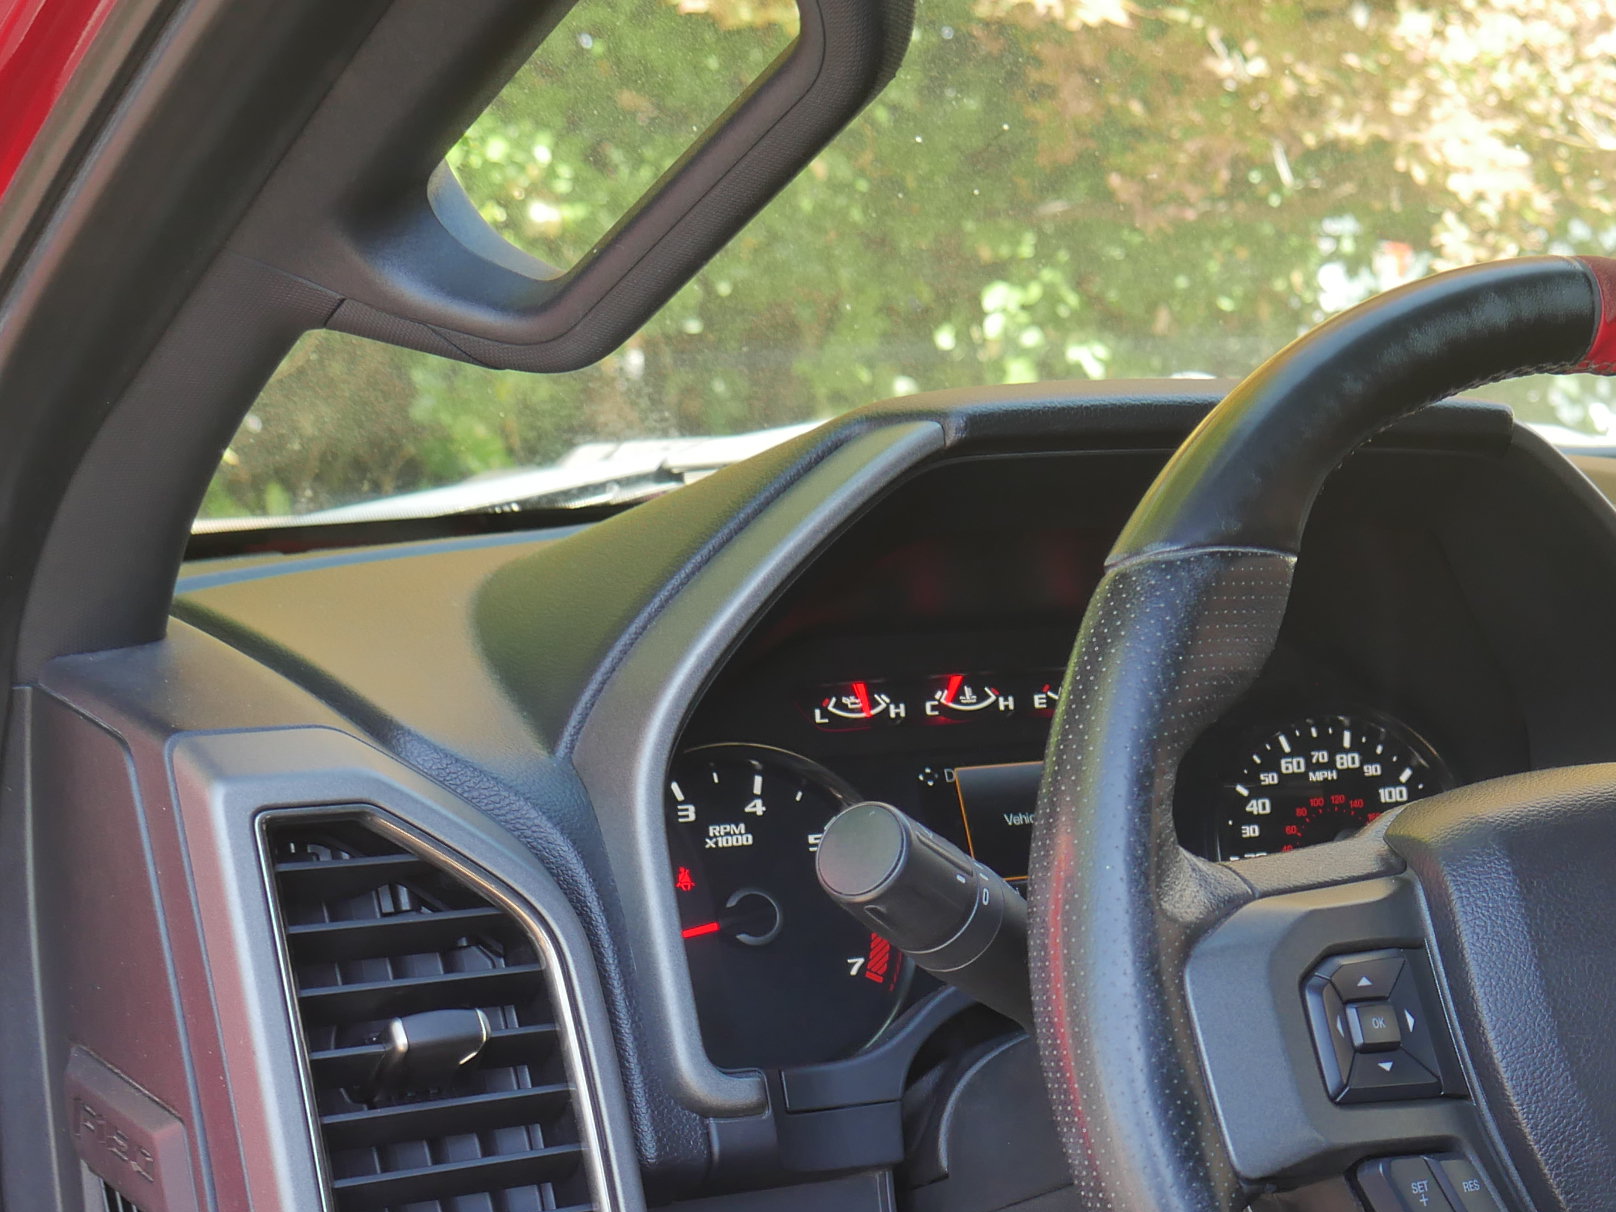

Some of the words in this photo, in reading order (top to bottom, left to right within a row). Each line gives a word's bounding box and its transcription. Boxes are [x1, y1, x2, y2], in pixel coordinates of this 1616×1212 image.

[925, 701, 939, 716] C
[1000, 696, 1015, 711] H
[1033, 694, 1048, 709] E
[814, 708, 829, 724] L
[889, 703, 906, 718] H
[1311, 750, 1329, 764] 70
[1335, 752, 1361, 769] 80
[1280, 757, 1306, 774] 60
[1363, 763, 1382, 777] 90
[1260, 772, 1279, 785] 50
[1308, 769, 1337, 782] MPH
[1309, 797, 1325, 807] 100
[1330, 794, 1345, 804] 120
[1378, 786, 1408, 803] 100
[677, 804, 696, 822] 3
[744, 798, 766, 816] 4
[1245, 798, 1271, 815] 40
[1296, 808, 1308, 817] 80
[708, 822, 746, 837] RPM
[1241, 824, 1260, 838] 30
[1285, 825, 1297, 835] 60
[846, 957, 865, 976] 7
[1371, 1016, 1387, 1031] OK
[1411, 1180, 1430, 1194] SET
[1462, 1179, 1481, 1193] RES
